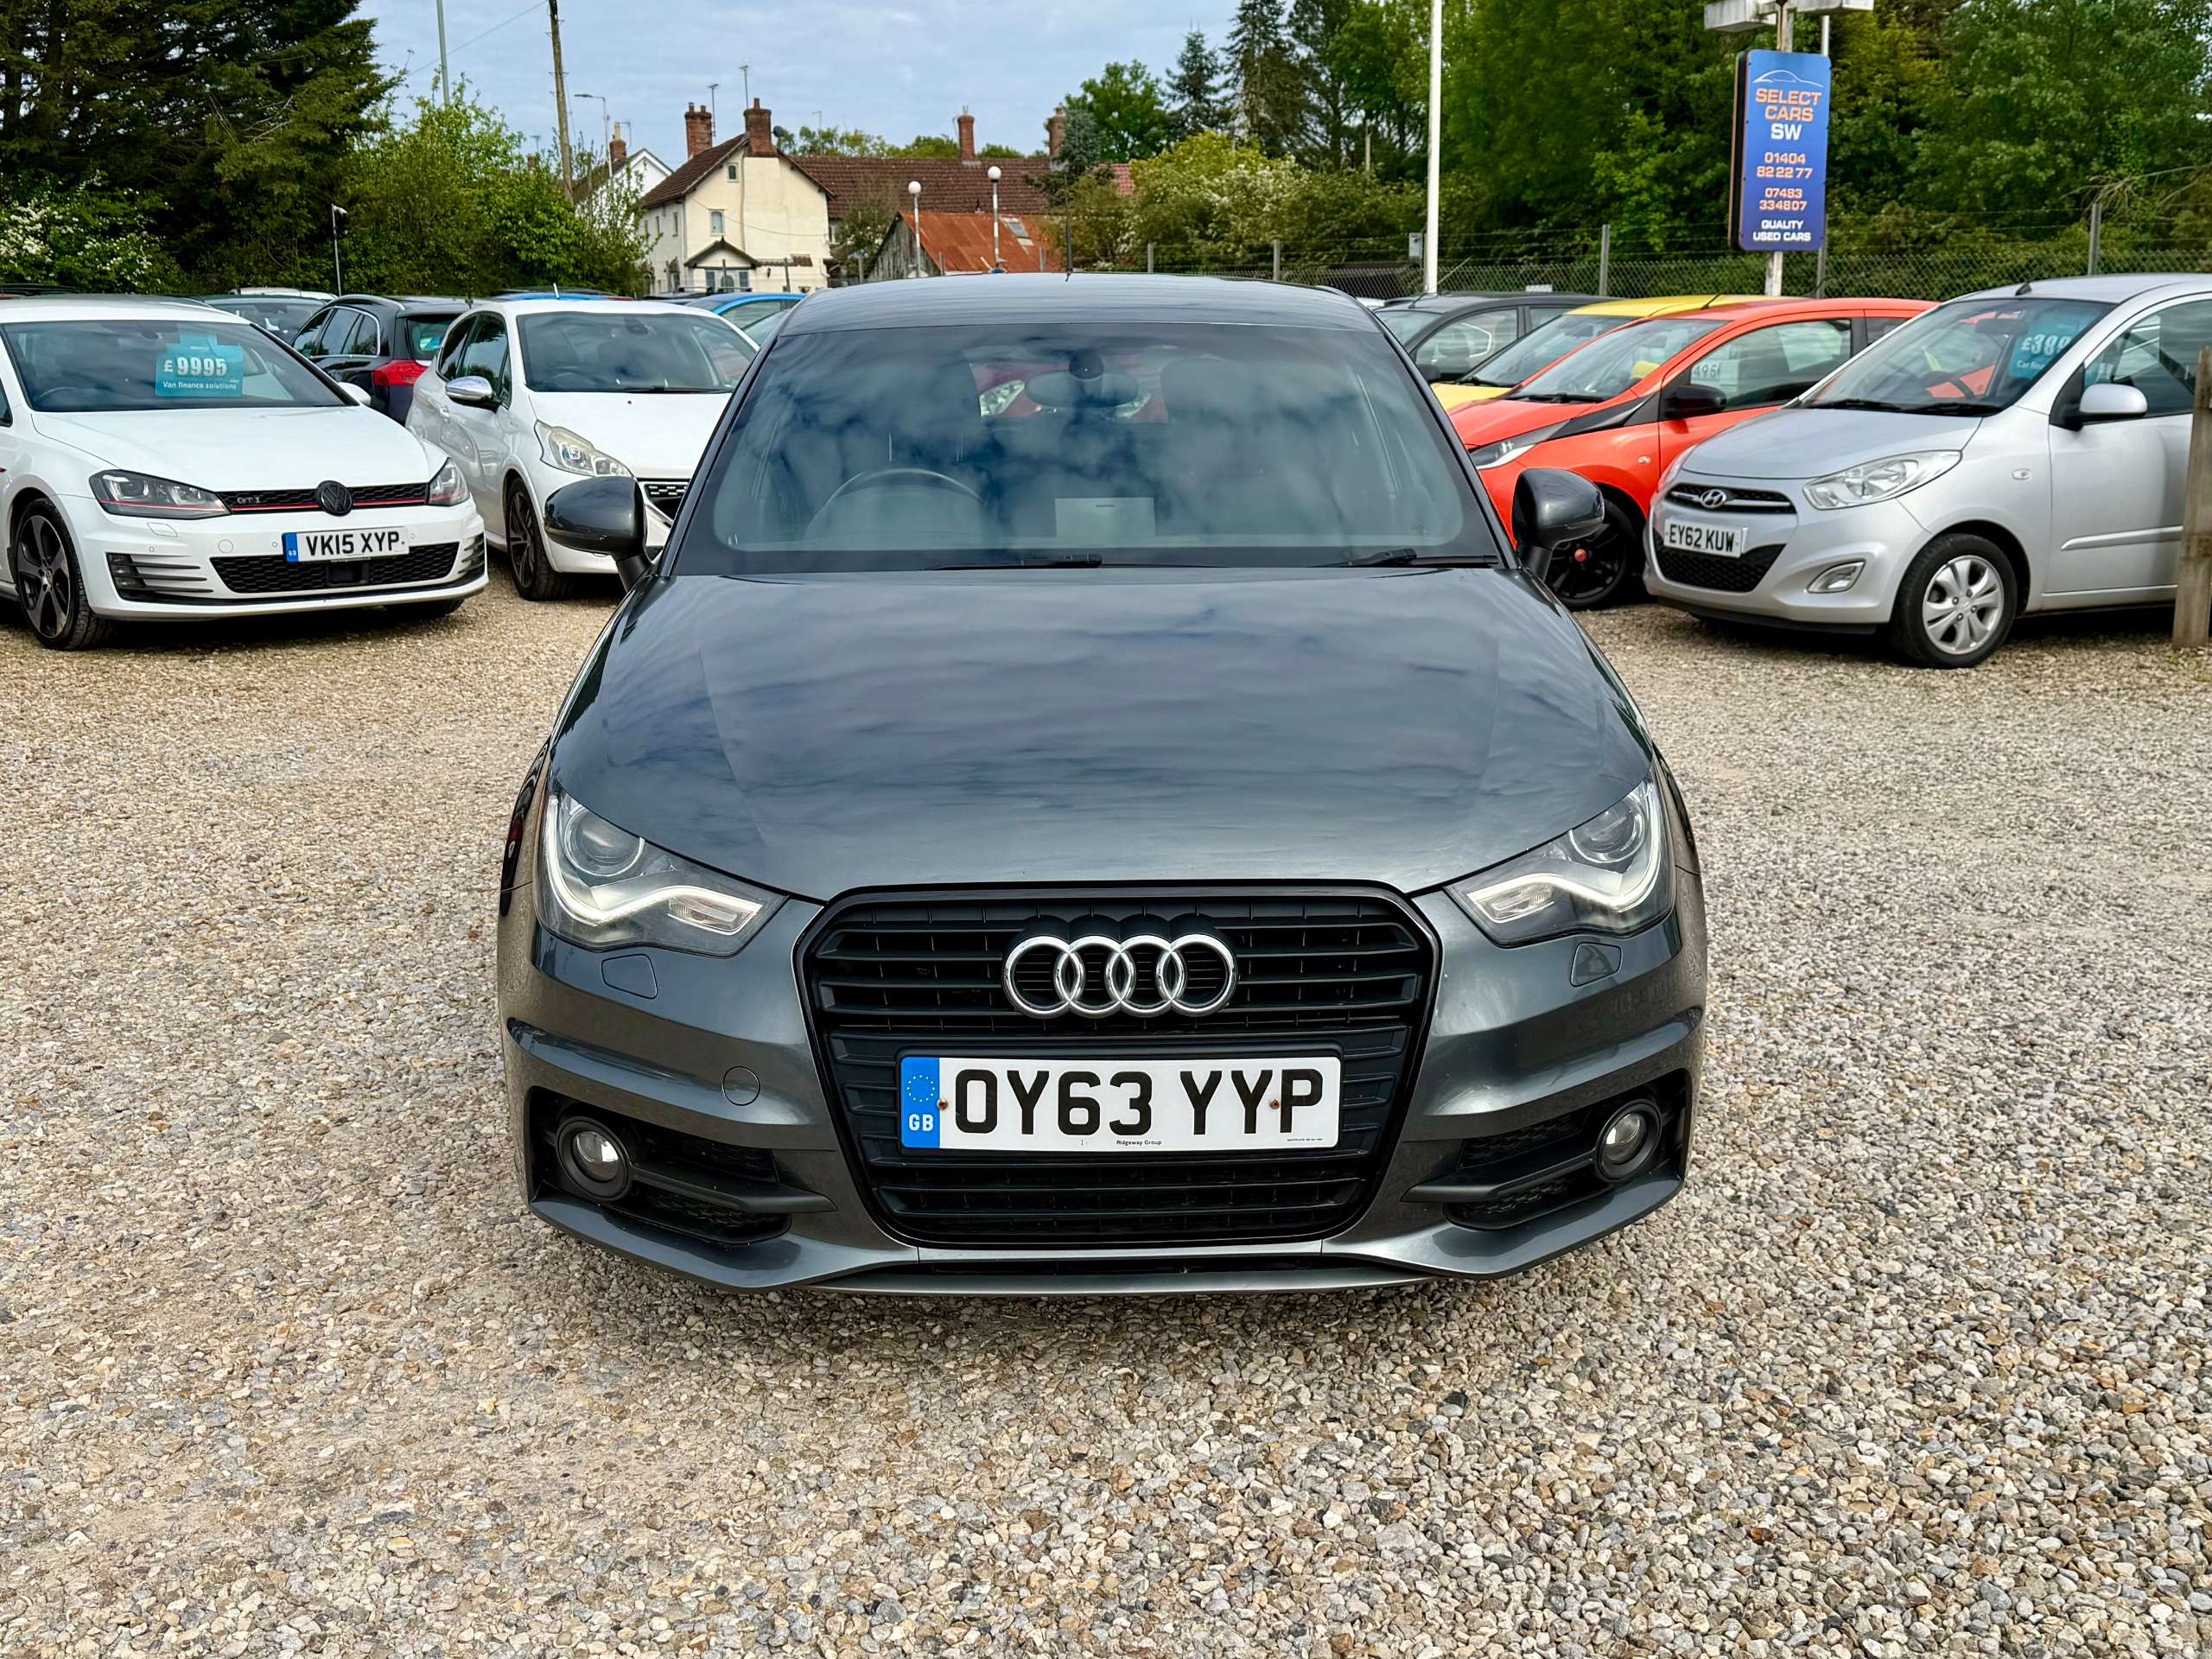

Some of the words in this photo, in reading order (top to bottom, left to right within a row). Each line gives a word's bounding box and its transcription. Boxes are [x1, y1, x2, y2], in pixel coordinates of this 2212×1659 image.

[1756, 88, 1822, 105] SELECT
[1764, 105, 1814, 122] CARS
[1770, 123, 1802, 140] SW
[1764, 151, 1806, 164] 01404
[1764, 188, 1803, 199] 07483
[1759, 200, 1808, 211] 334807
[1761, 219, 1804, 230] QUALITY
[1752, 232, 1781, 241] USED
[1783, 232, 1812, 241] CARS
[306, 534, 354, 556] VK15
[360, 531, 400, 553] XYP
[1669, 524, 1702, 548] EY62
[1706, 529, 1734, 552] KUW
[955, 1068, 1153, 1136] OY63
[1179, 1068, 1324, 1135] YYP
[909, 1114, 933, 1131] GB
